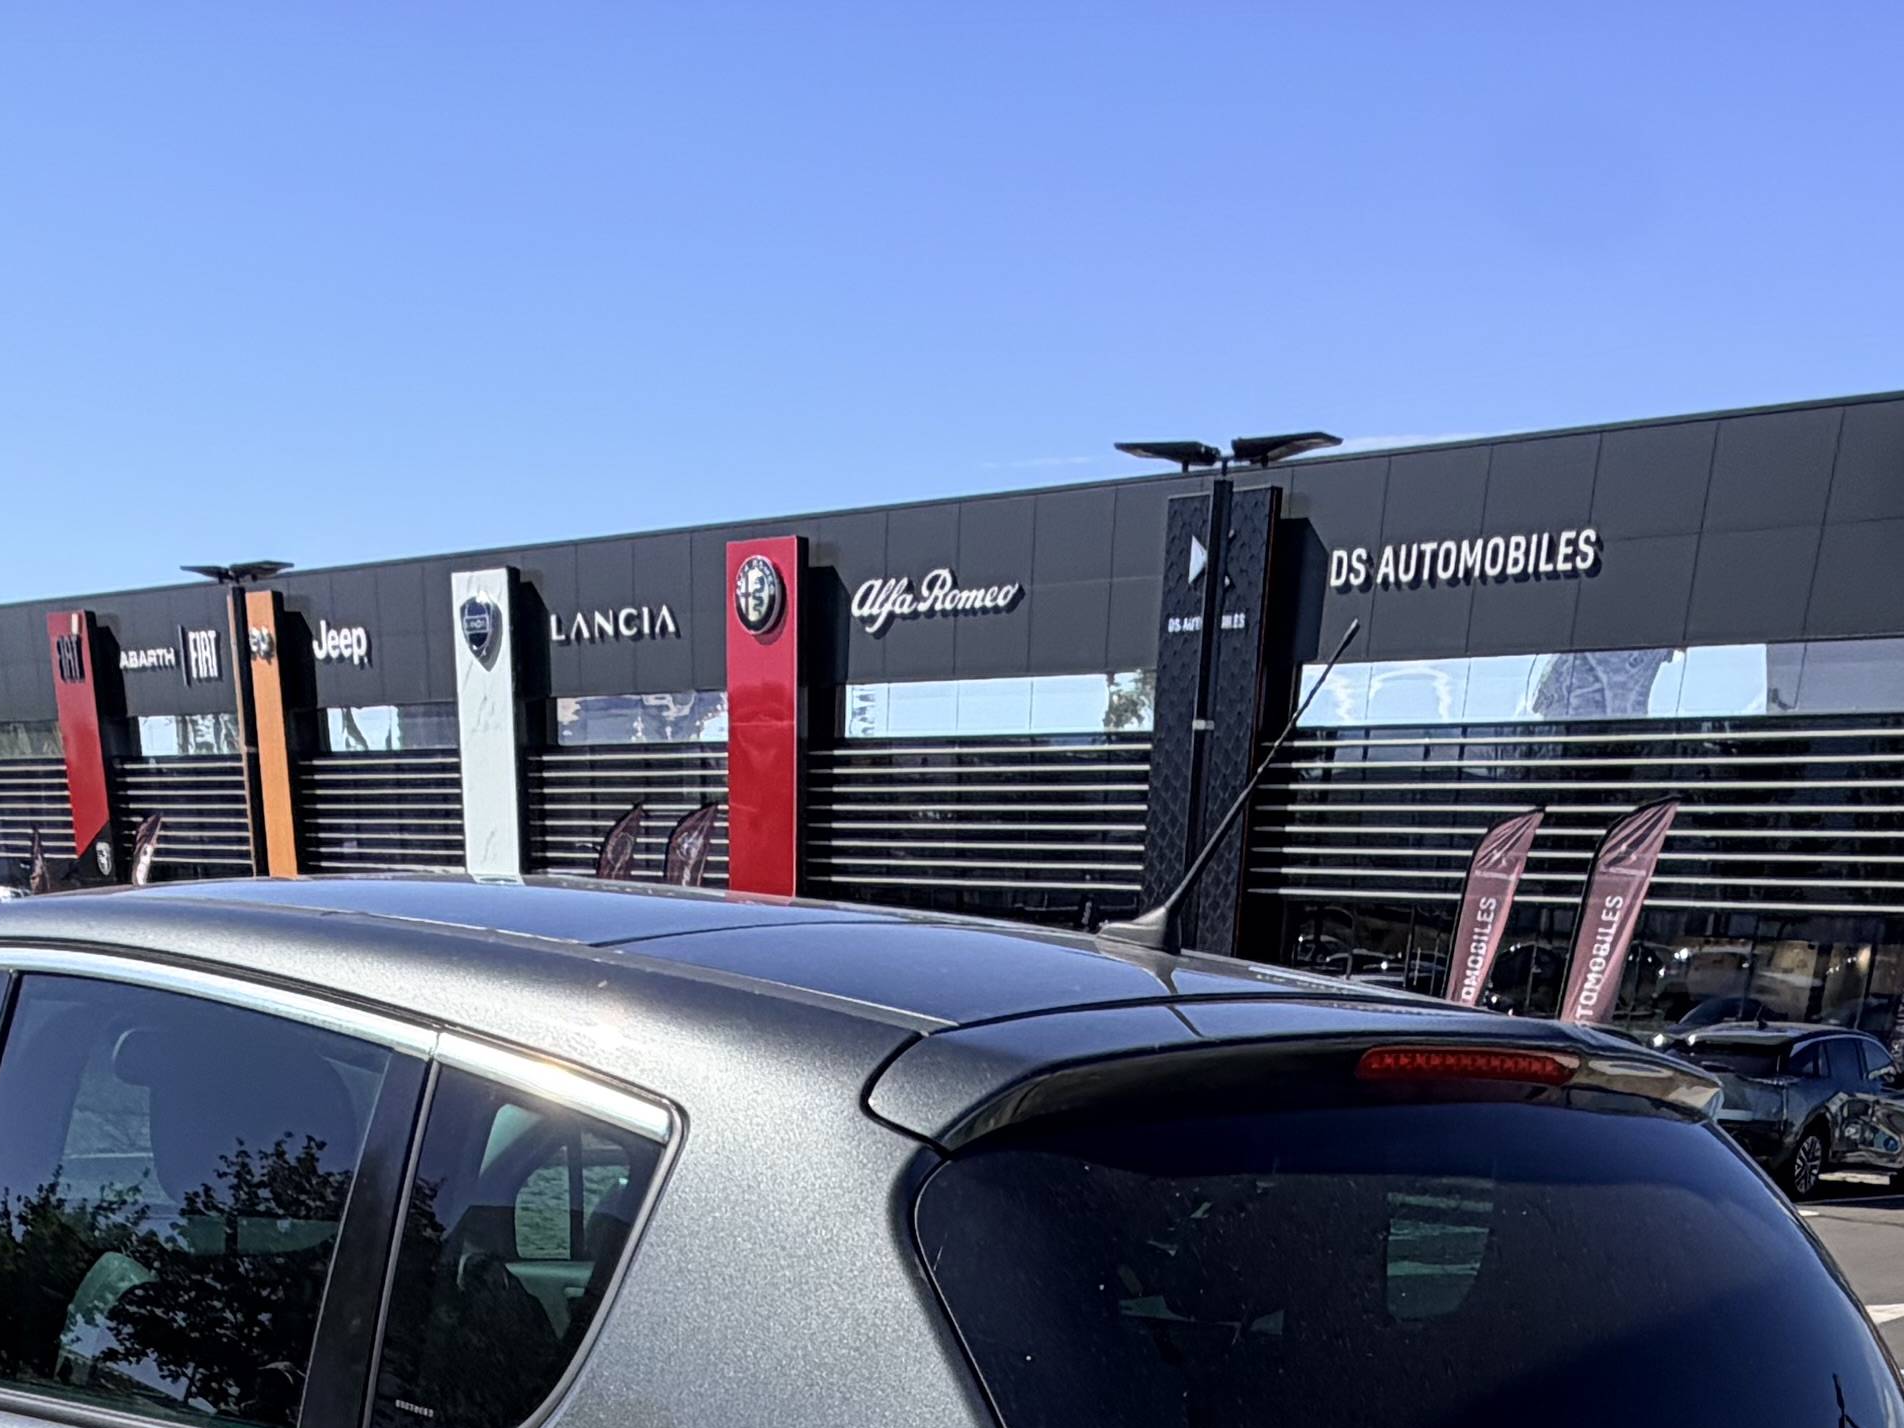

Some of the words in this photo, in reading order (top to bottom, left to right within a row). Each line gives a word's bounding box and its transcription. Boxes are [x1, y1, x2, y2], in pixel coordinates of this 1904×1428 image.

[1329, 548, 1368, 588] DS
[1375, 528, 1596, 585] AUTOMOBILES
[550, 604, 676, 641] LANCIA
[851, 576, 917, 634] Alfa
[917, 568, 1019, 612] Romeo
[118, 647, 175, 670] ABARTH
[188, 630, 218, 679] FIAT
[312, 619, 369, 665] Jeep
[1460, 896, 1498, 1002] OMOBILES
